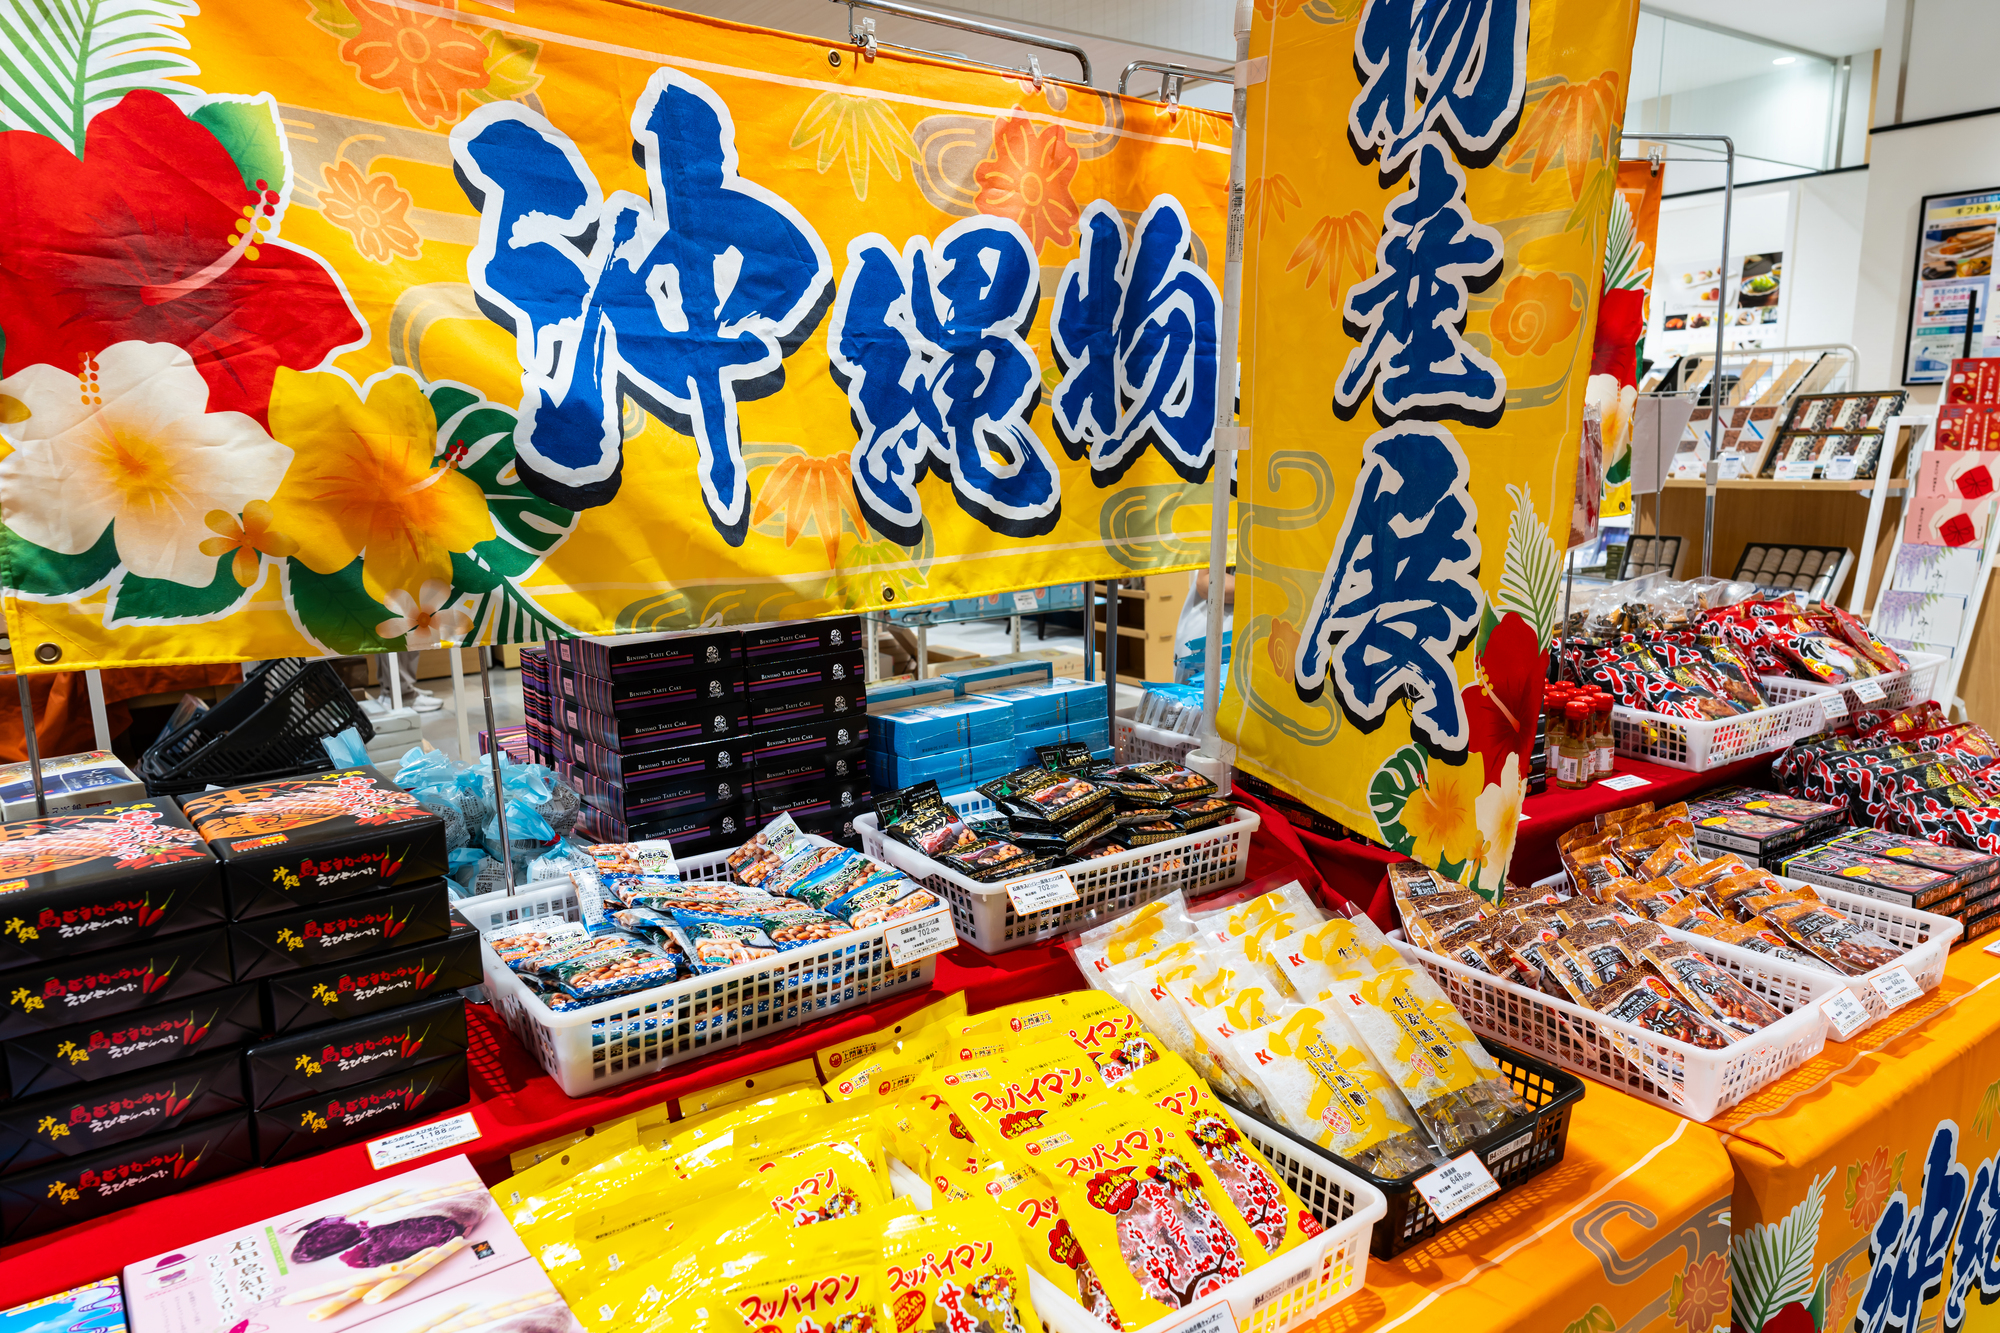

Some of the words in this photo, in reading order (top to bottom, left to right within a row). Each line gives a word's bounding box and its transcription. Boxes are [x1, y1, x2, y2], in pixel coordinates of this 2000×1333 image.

[1392, 996, 1449, 1058] 生姜黒糖
[972, 1067, 1082, 1114] スッパイマン
[1006, 1116, 1041, 1138] たねぬき
[1056, 1126, 1164, 1178] スッパイマン
[1094, 1172, 1134, 1207] たねぬき
[1141, 1183, 1192, 1256] 梅キャンディー
[886, 1240, 994, 1293] スッパイマン
[740, 1274, 860, 1327] スッパイマン
